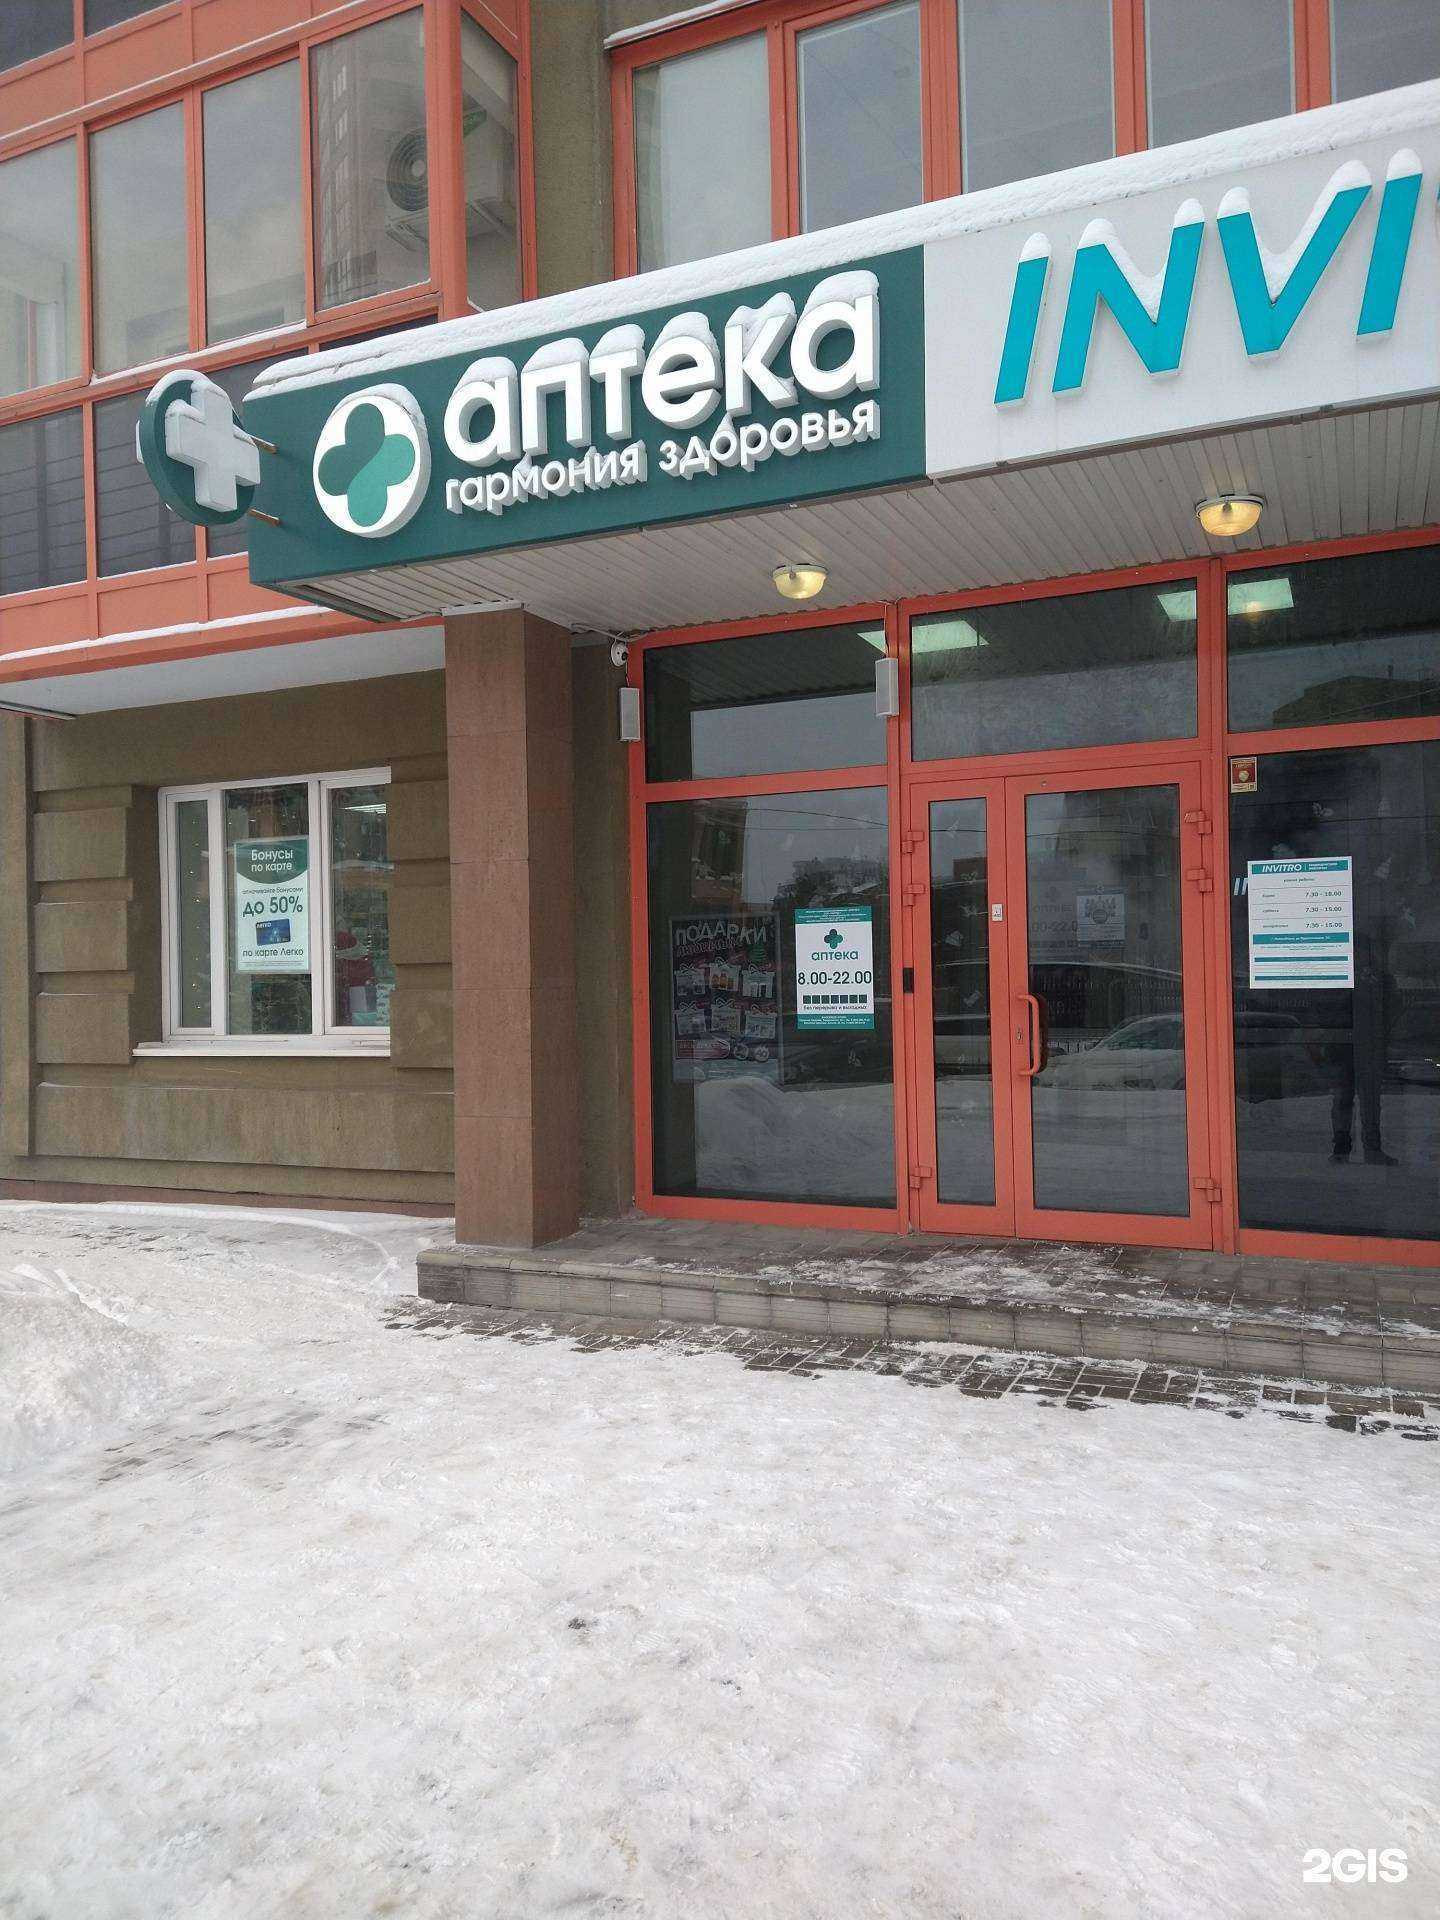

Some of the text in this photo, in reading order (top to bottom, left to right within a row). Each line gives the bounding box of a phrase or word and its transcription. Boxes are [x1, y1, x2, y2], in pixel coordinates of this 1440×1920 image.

[994, 173, 1440, 406] INVI
[444, 293, 880, 467] аптека
[444, 399, 881, 515] гармония здоровья
[251, 849, 293, 862] Бонусы
[251, 862, 292, 872] по карте
[1262, 864, 1302, 872] INVITRO
[242, 896, 304, 917] до 50%
[675, 921, 767, 946] ПОДАРКИ
[255, 948, 278, 957] карте
[280, 947, 304, 956] Легко
[811, 950, 859, 961] аптека
[797, 971, 872, 985] 8.00-22.00
